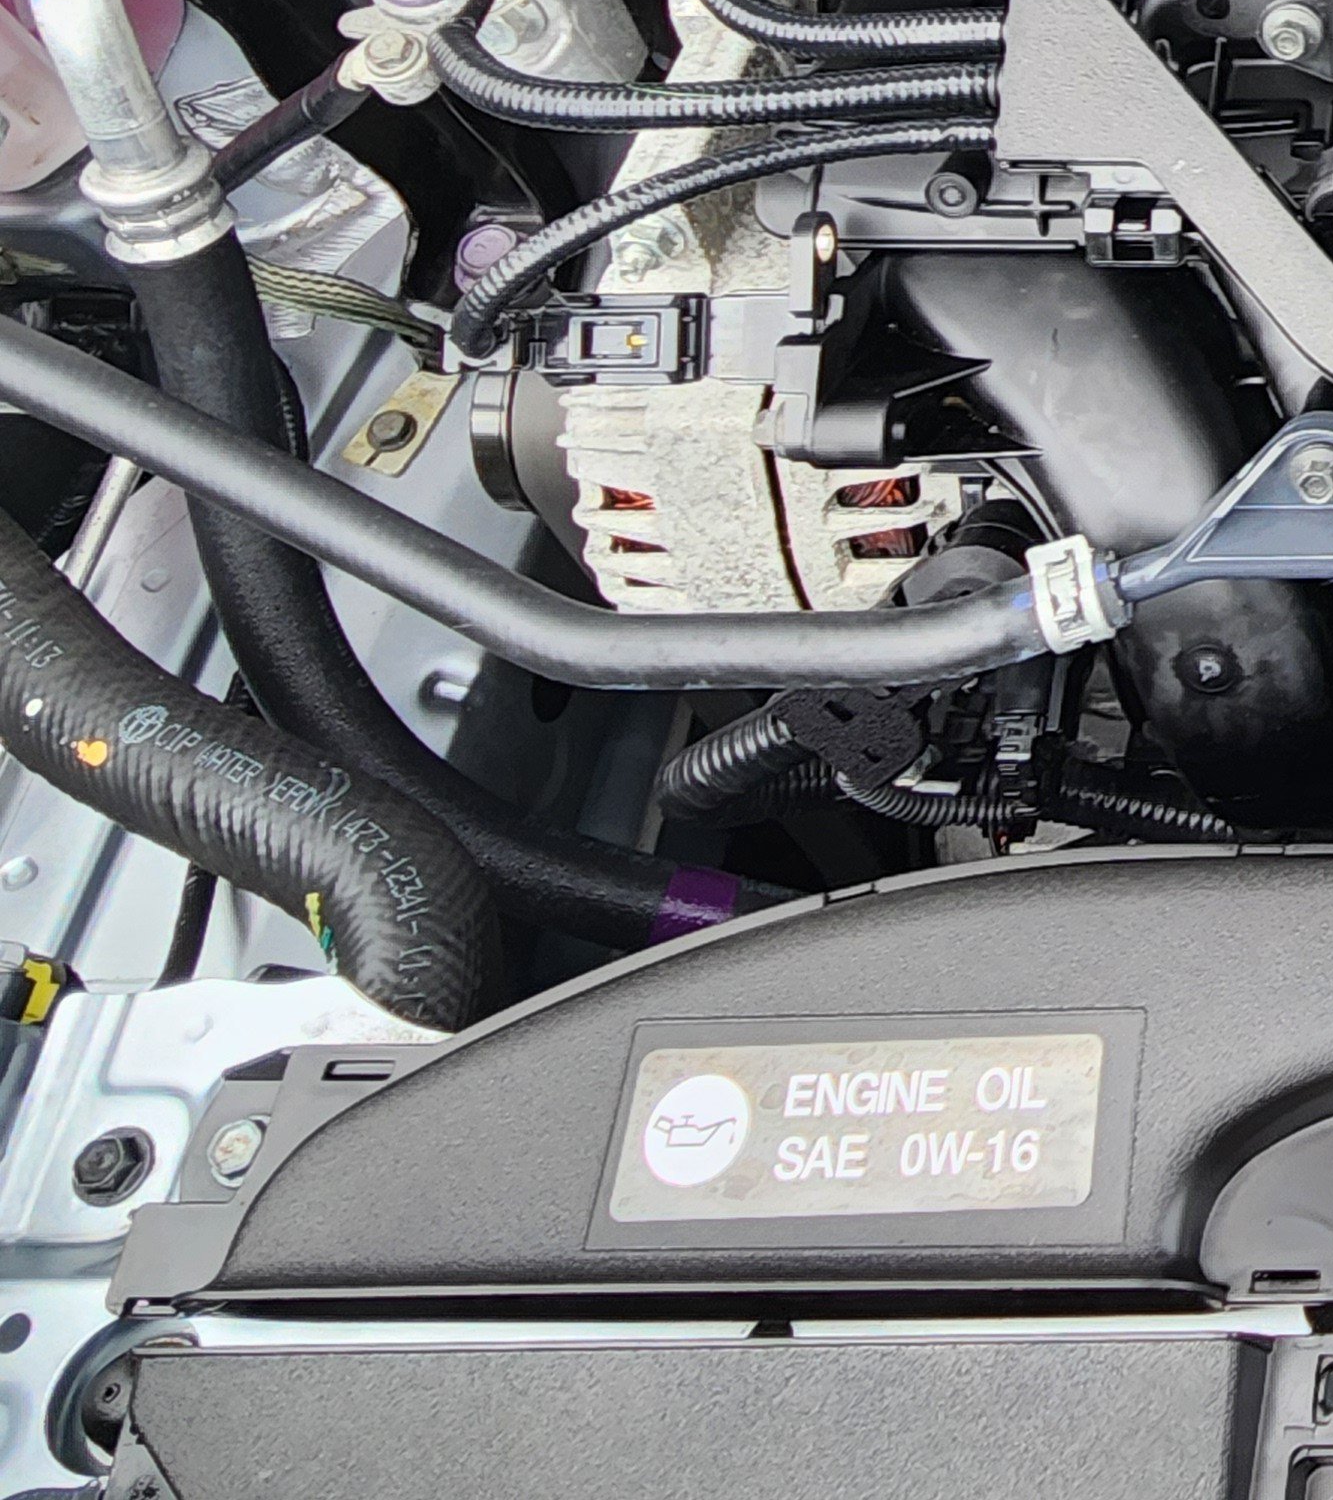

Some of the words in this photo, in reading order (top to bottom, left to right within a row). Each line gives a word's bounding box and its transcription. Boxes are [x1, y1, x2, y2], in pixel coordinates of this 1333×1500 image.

[783, 1069, 950, 1119] ENGINE
[975, 1065, 1047, 1112] OIL
[773, 1133, 870, 1182] SAE
[900, 1129, 1041, 1177] 0W-16
